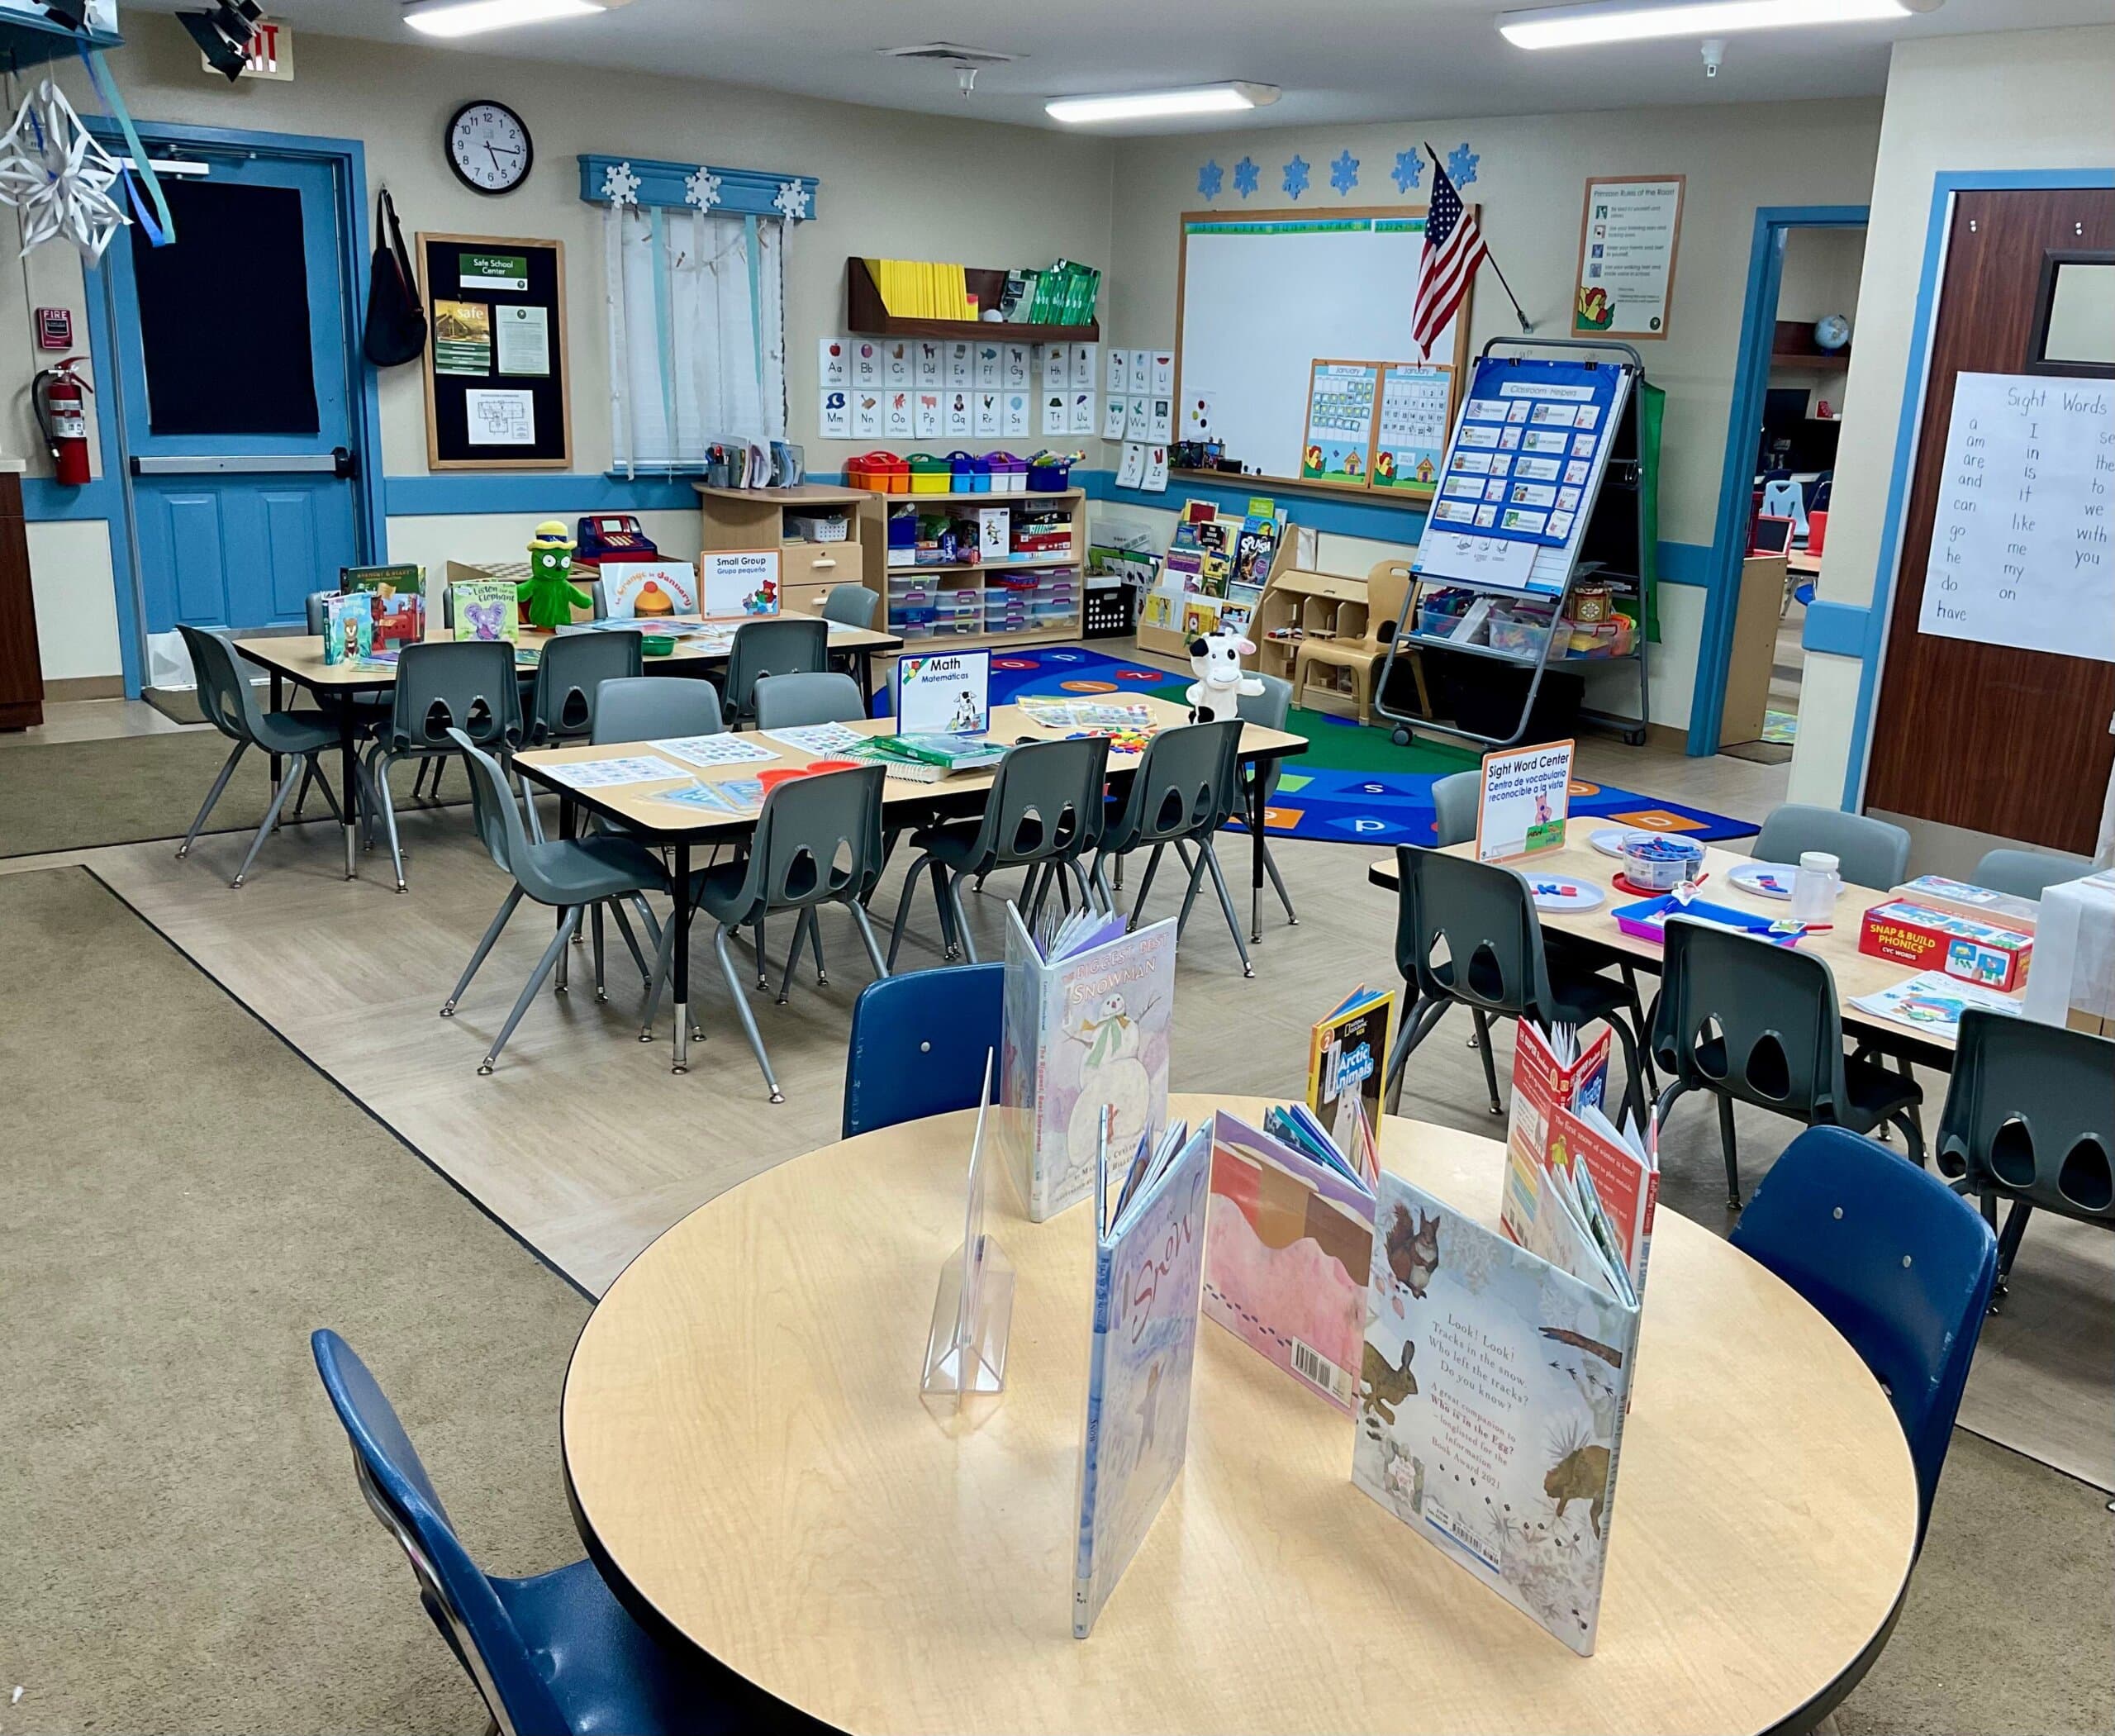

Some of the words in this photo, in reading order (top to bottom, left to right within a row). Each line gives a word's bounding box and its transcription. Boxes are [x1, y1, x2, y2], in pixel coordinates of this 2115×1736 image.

[469, 117, 478, 126] 11
[482, 112, 493, 122] 12
[499, 119, 503, 128] 1
[461, 125, 471, 135] 10
[509, 129, 516, 139] 2
[457, 140, 464, 150] 9
[514, 145, 521, 155] 3
[463, 155, 469, 165] 8
[511, 159, 516, 169] 4
[473, 168, 481, 177] 7
[487, 172, 494, 182] 6
[501, 169, 508, 179] 5
[473, 258, 489, 268] Safe
[490, 259, 514, 269] School
[482, 266, 506, 276] Center
[43, 310, 68, 319] FIRE
[457, 307, 484, 320] safe
[828, 362, 843, 373] Aa
[860, 363, 873, 373] Bb
[891, 363, 905, 374] Cc
[923, 363, 935, 374] Dd
[953, 364, 965, 375] Ee
[983, 364, 992, 376] Ff
[1010, 365, 1024, 378] Gg
[1050, 366, 1061, 376] Hh
[1509, 385, 1547, 395] Classroom
[1549, 388, 1577, 397] Helpers
[2008, 387, 2046, 416] Sight
[2063, 392, 2108, 415] Words
[827, 412, 844, 424] Mm
[861, 413, 873, 424] Nn
[891, 413, 905, 424] Oo
[923, 412, 935, 426] Pp
[952, 413, 966, 426] Qq
[982, 413, 992, 424] Rr
[1010, 414, 1020, 425] Ss
[1050, 411, 1061, 421] Tt
[1077, 412, 1088, 421] Uu
[1130, 417, 1146, 428] Ww
[1969, 419, 1978, 430] a
[2029, 422, 2039, 439] I
[1966, 435, 1984, 448] am
[2026, 445, 2040, 460] in
[1963, 455, 1984, 468] are
[2096, 454, 2115, 473] the
[2024, 464, 2037, 480] is
[1958, 473, 1983, 489] and
[2091, 478, 2104, 495] to
[2019, 486, 2033, 503] it
[1953, 498, 1976, 512] can
[2084, 503, 2104, 517] we
[2012, 512, 2036, 532] like
[1950, 524, 1966, 542] go
[2076, 525, 2108, 543] with
[1240, 535, 1271, 555] SPLASH
[2008, 542, 2027, 556] me
[716, 558, 739, 567] Small
[740, 556, 767, 568] Group
[1946, 547, 1961, 564] he
[2075, 549, 2100, 569] you
[737, 565, 767, 575] pequeño
[2003, 564, 2025, 584] my
[473, 585, 498, 595] Listen
[656, 571, 692, 606] January
[1941, 574, 1958, 592] do
[478, 592, 515, 602] Elephant
[1999, 588, 2017, 602] on
[1936, 600, 1967, 621] have
[930, 657, 961, 672] Math
[1488, 762, 1511, 779] Sight
[1514, 756, 1538, 773] Word
[1539, 753, 1570, 768] Center
[1488, 778, 1513, 792] Centro
[1514, 777, 1524, 787] de
[1525, 769, 1566, 784] vocabulario
[1489, 787, 1532, 802] reconocible
[1539, 783, 1547, 792] la
[1547, 779, 1564, 790] vista
[1140, 931, 1170, 954] BEST
[1870, 923, 1896, 936] SNAP
[1897, 929, 1906, 939] &
[1906, 932, 1936, 949] BUILD
[1878, 935, 1924, 954] PHONICS
[1881, 946, 1894, 956] CVC
[1894, 949, 1918, 961] WORDS
[1072, 955, 1157, 1005] SNOWMAN
[1324, 1035, 1330, 1049] 2
[1338, 1044, 1368, 1071] Arctic
[1337, 1059, 1372, 1092] nimals
[1554, 1114, 1565, 1127] The
[1564, 1119, 1577, 1136] first
[1576, 1132, 1594, 1147] snow
[1593, 1144, 1601, 1153] of
[1621, 1162, 1636, 1178] here!
[1447, 1313, 1479, 1341] Look!
[1483, 1334, 1515, 1363] Look!
[1432, 1321, 1464, 1349] Tracks
[1467, 1344, 1476, 1357] in
[1480, 1353, 1496, 1369] the
[1498, 1367, 1528, 1389] snow.
[1428, 1335, 1451, 1357] Who
[1453, 1351, 1470, 1370] left
[1472, 1365, 1488, 1382] the
[1491, 1376, 1529, 1405] tracks?
[1440, 1359, 1455, 1377] Do
[1456, 1375, 1476, 1391] you
[1479, 1384, 1513, 1413] know?
[1431, 1382, 1438, 1391] A
[1439, 1388, 1460, 1406] great
[1461, 1402, 1506, 1436] companion
[1507, 1433, 1517, 1443] to
[1430, 1393, 1451, 1414] Who
[1452, 1408, 1461, 1421] is
[1462, 1415, 1471, 1429] in
[1474, 1423, 1489, 1439] the
[1491, 1434, 1514, 1455] Egg?
[1440, 1414, 1478, 1446] longlisted
[1480, 1440, 1493, 1456] for
[1495, 1453, 1508, 1467] the
[1445, 1431, 1492, 1469] Information
[1431, 1435, 1451, 1456] Book
[1453, 1453, 1480, 1477] Award
[1481, 1471, 1500, 1489] 2021
